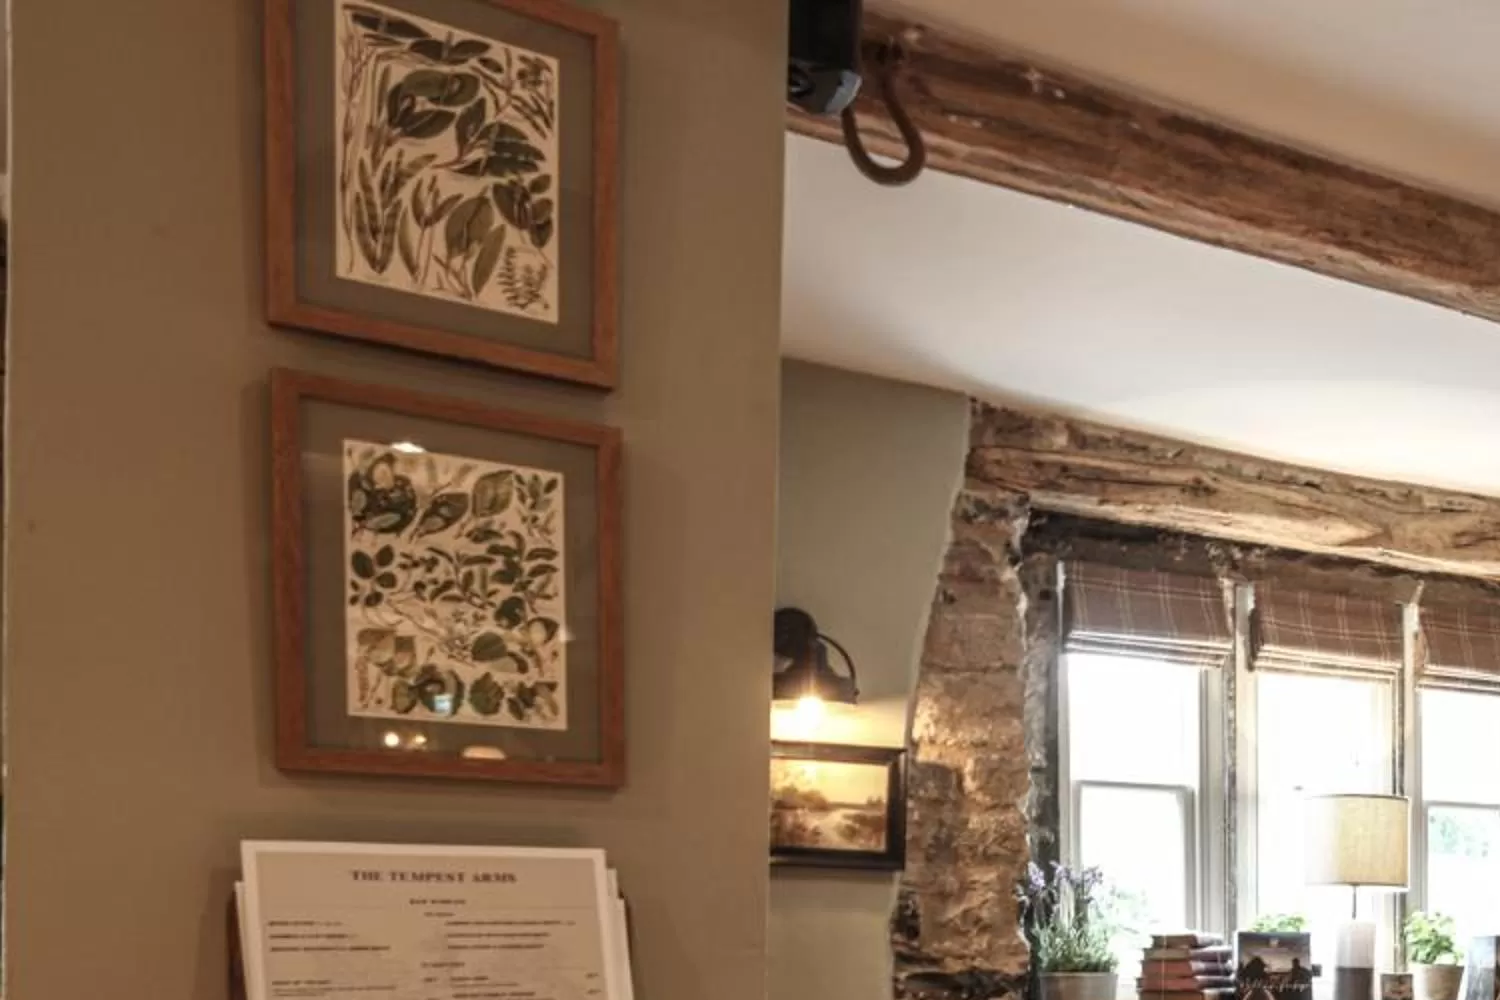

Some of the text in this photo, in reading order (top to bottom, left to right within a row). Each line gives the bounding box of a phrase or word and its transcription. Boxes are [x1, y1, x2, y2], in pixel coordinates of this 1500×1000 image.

[350, 870, 517, 883] THE TEMPEST ARMS
